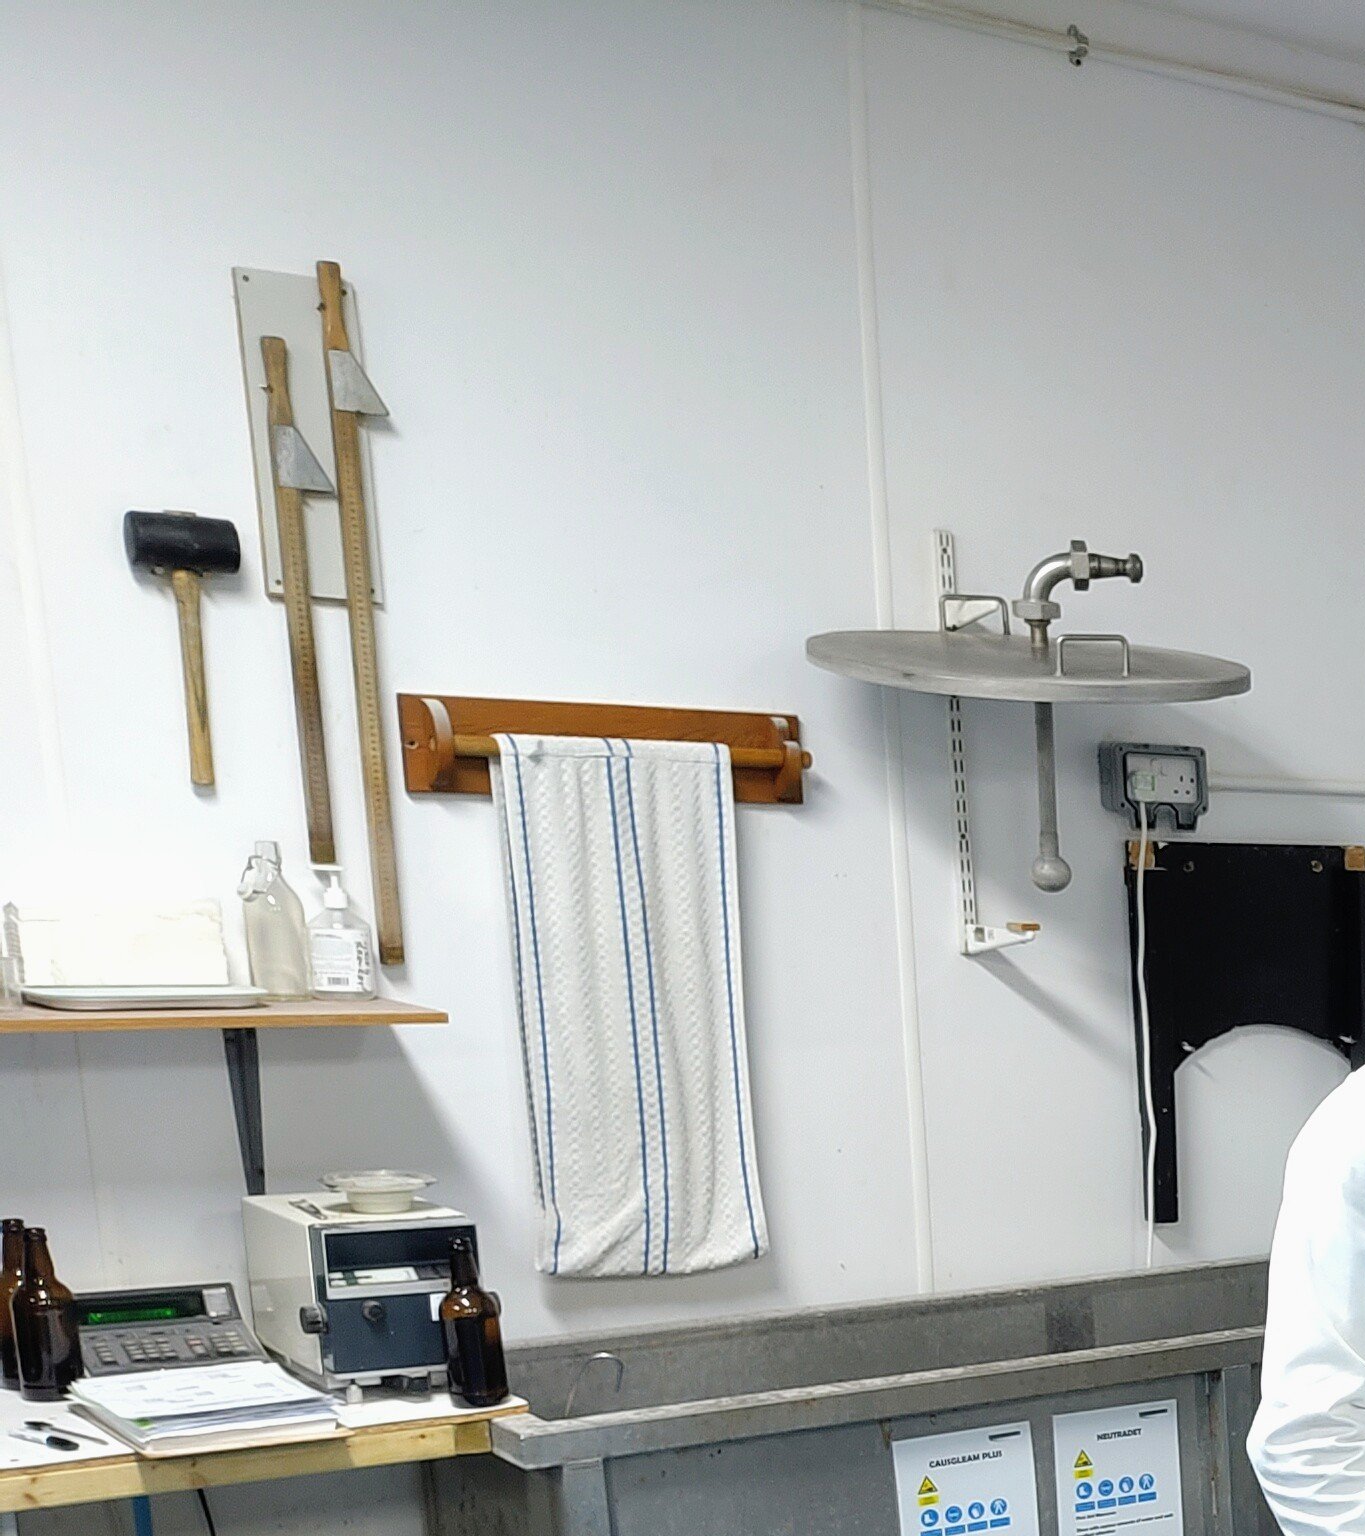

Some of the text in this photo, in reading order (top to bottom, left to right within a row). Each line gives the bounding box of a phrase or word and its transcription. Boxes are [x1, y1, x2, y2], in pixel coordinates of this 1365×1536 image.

[1097, 1428, 1142, 1441] NEUTRADET
[929, 1450, 1002, 1468] CAUSGLEAM PLUS
